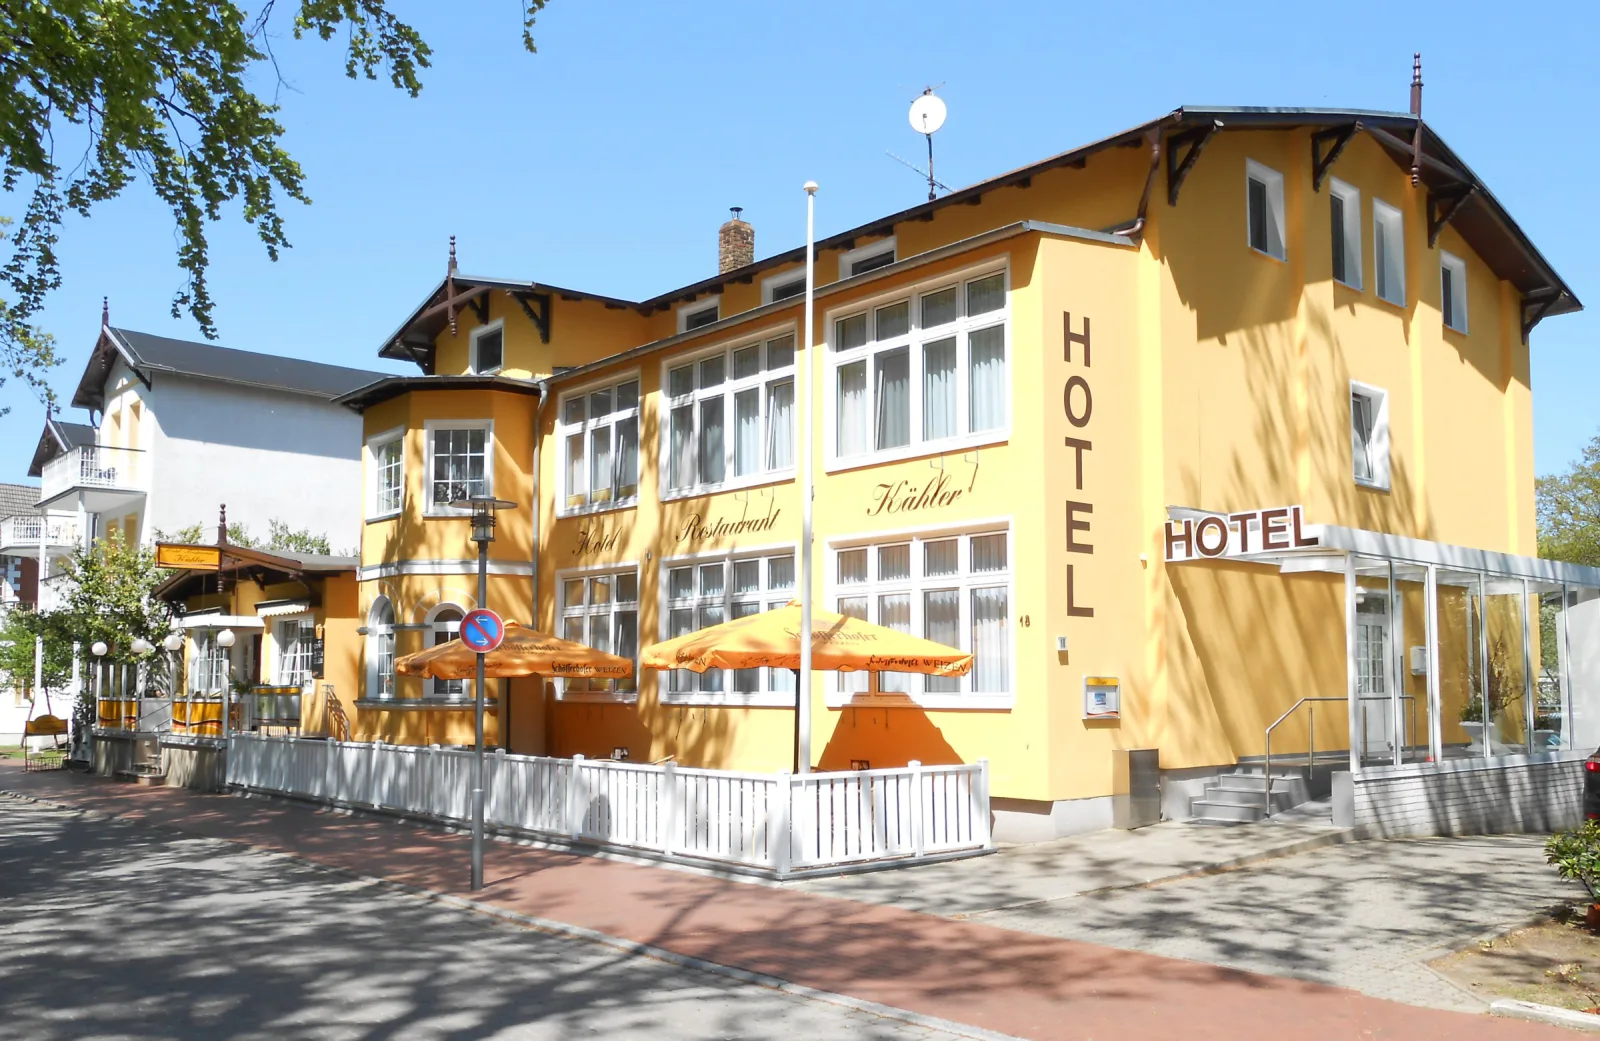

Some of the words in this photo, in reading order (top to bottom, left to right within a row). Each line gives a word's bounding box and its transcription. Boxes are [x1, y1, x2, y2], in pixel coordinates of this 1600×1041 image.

[1063, 310, 1094, 618] HOTEL
[572, 526, 622, 556] Hotel
[676, 509, 780, 542] Restaurant
[867, 474, 963, 516] Kähler
[1165, 506, 1319, 560] HOTEL
[923, 658, 968, 673] WEIZEN
